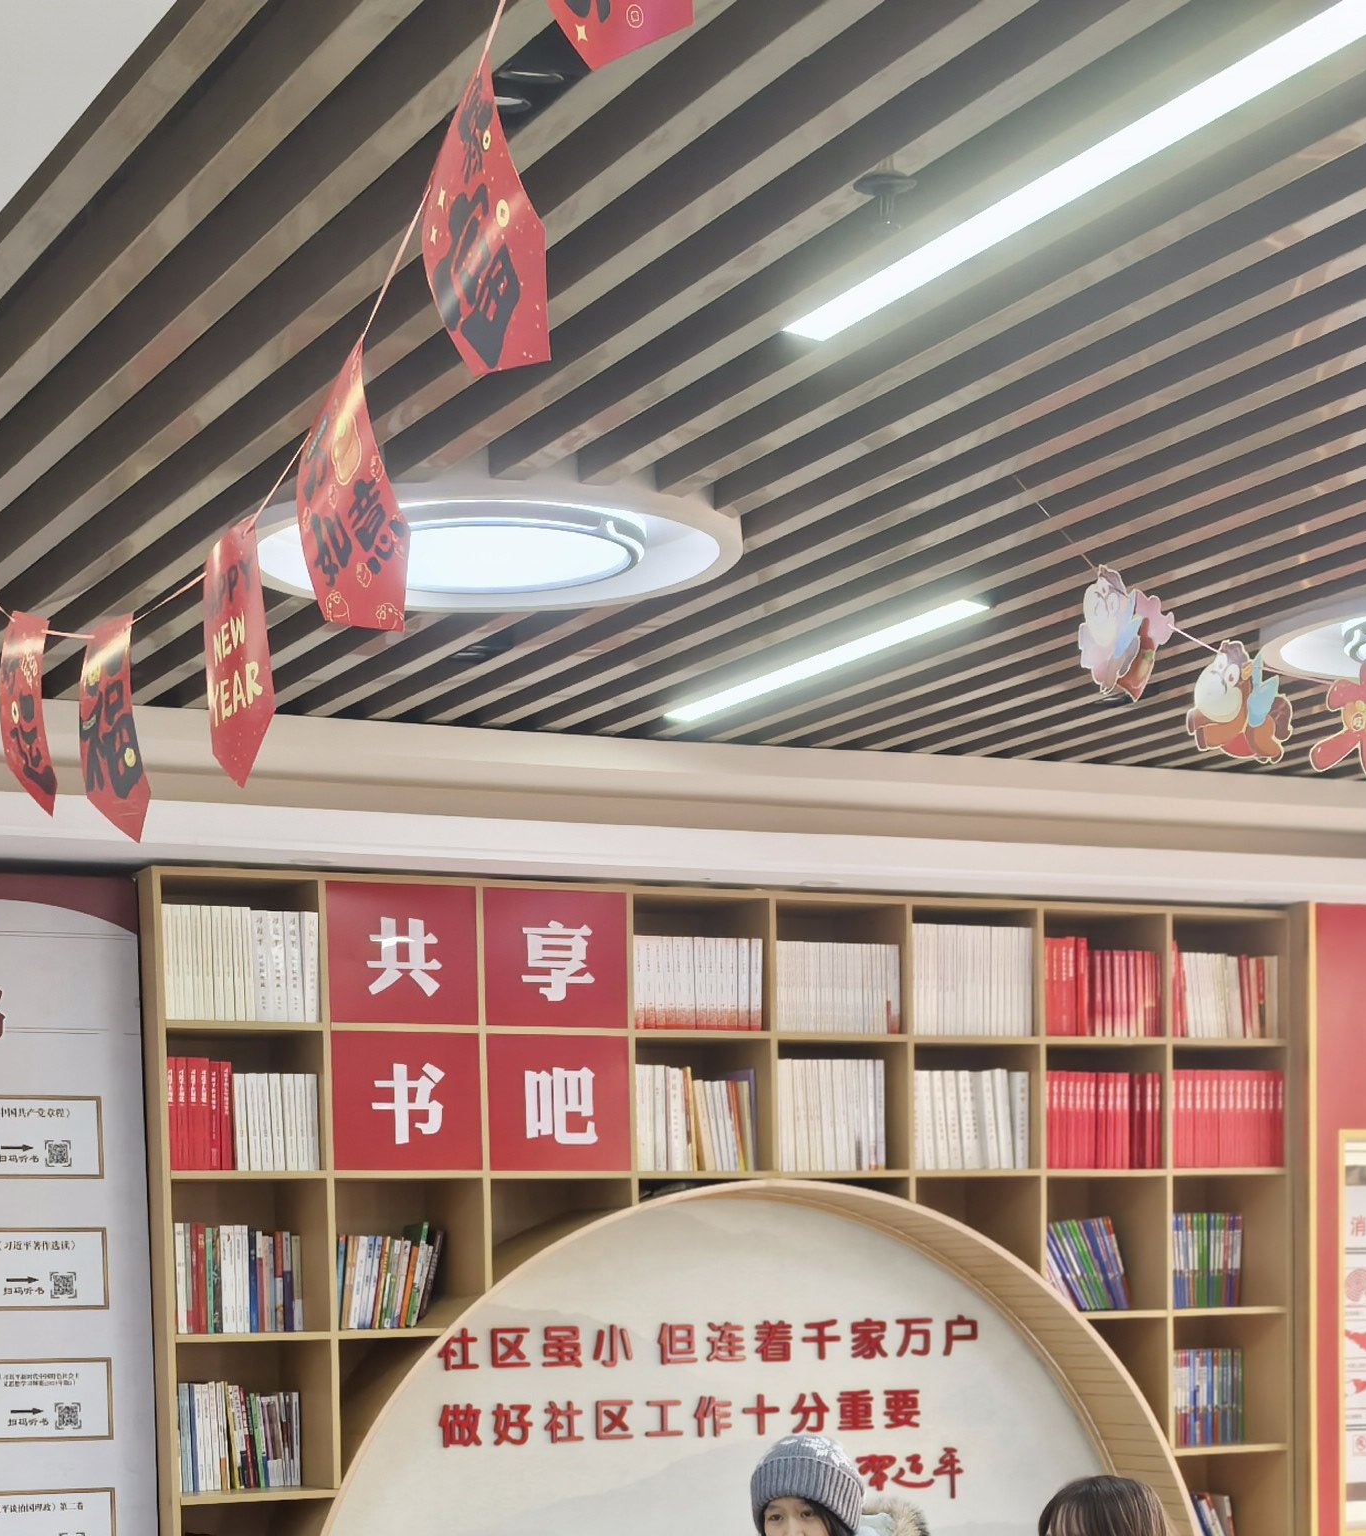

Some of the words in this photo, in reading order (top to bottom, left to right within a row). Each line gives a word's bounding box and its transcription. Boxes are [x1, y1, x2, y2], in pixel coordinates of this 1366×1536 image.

[213, 609, 246, 667] NEW
[211, 661, 263, 727] YEAR
[366, 916, 596, 1002] 共享
[371, 1062, 599, 1145] 书吧
[2, 1286, 45, 1297] 扫码听书
[438, 1324, 633, 1371] 社区虽小
[657, 1314, 979, 1366] 但连着千家万户
[7, 1417, 50, 1427] 扫码听书
[438, 1388, 922, 1448] 做好社区工作十分重要
